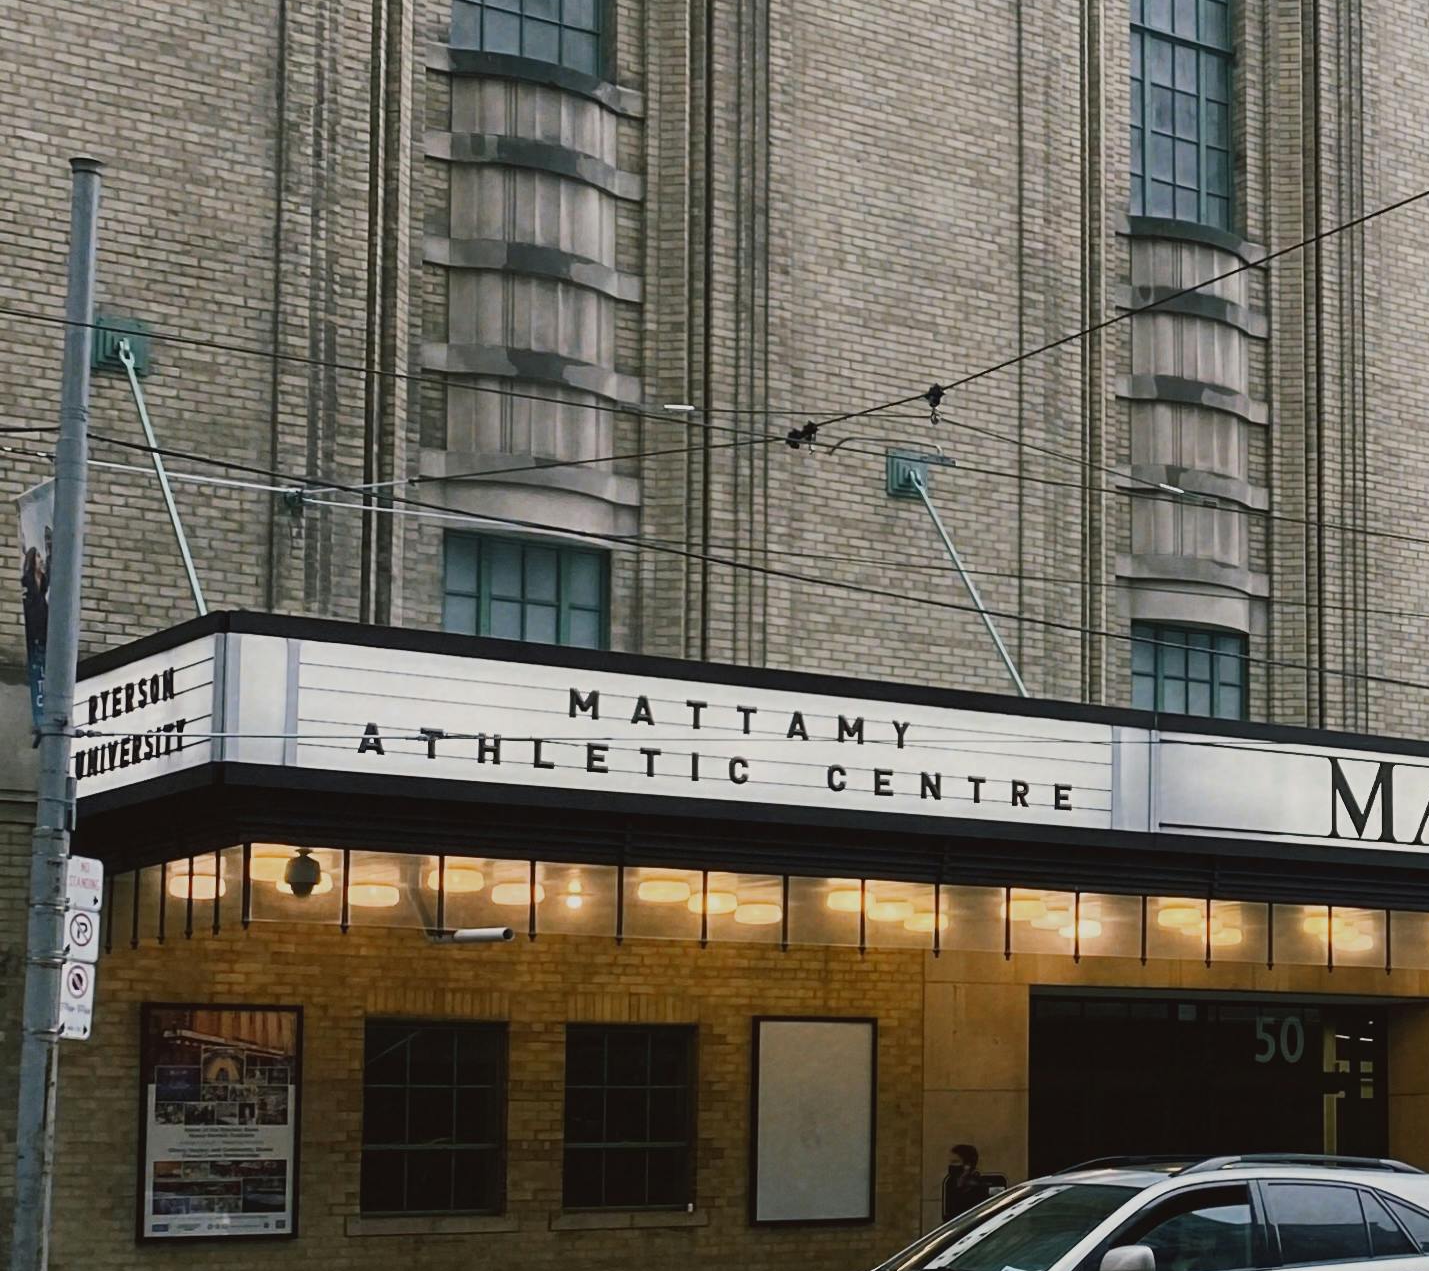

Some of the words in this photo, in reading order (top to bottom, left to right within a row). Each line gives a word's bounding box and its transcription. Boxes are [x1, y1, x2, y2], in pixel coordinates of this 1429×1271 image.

[88, 667, 175, 725] RYERSON
[569, 687, 911, 749] MATTAMY
[75, 718, 187, 780] UNIVERSITY
[357, 722, 750, 786] ATHLETIC
[826, 764, 1073, 811] CENTRE
[1254, 1016, 1304, 1063] 50
